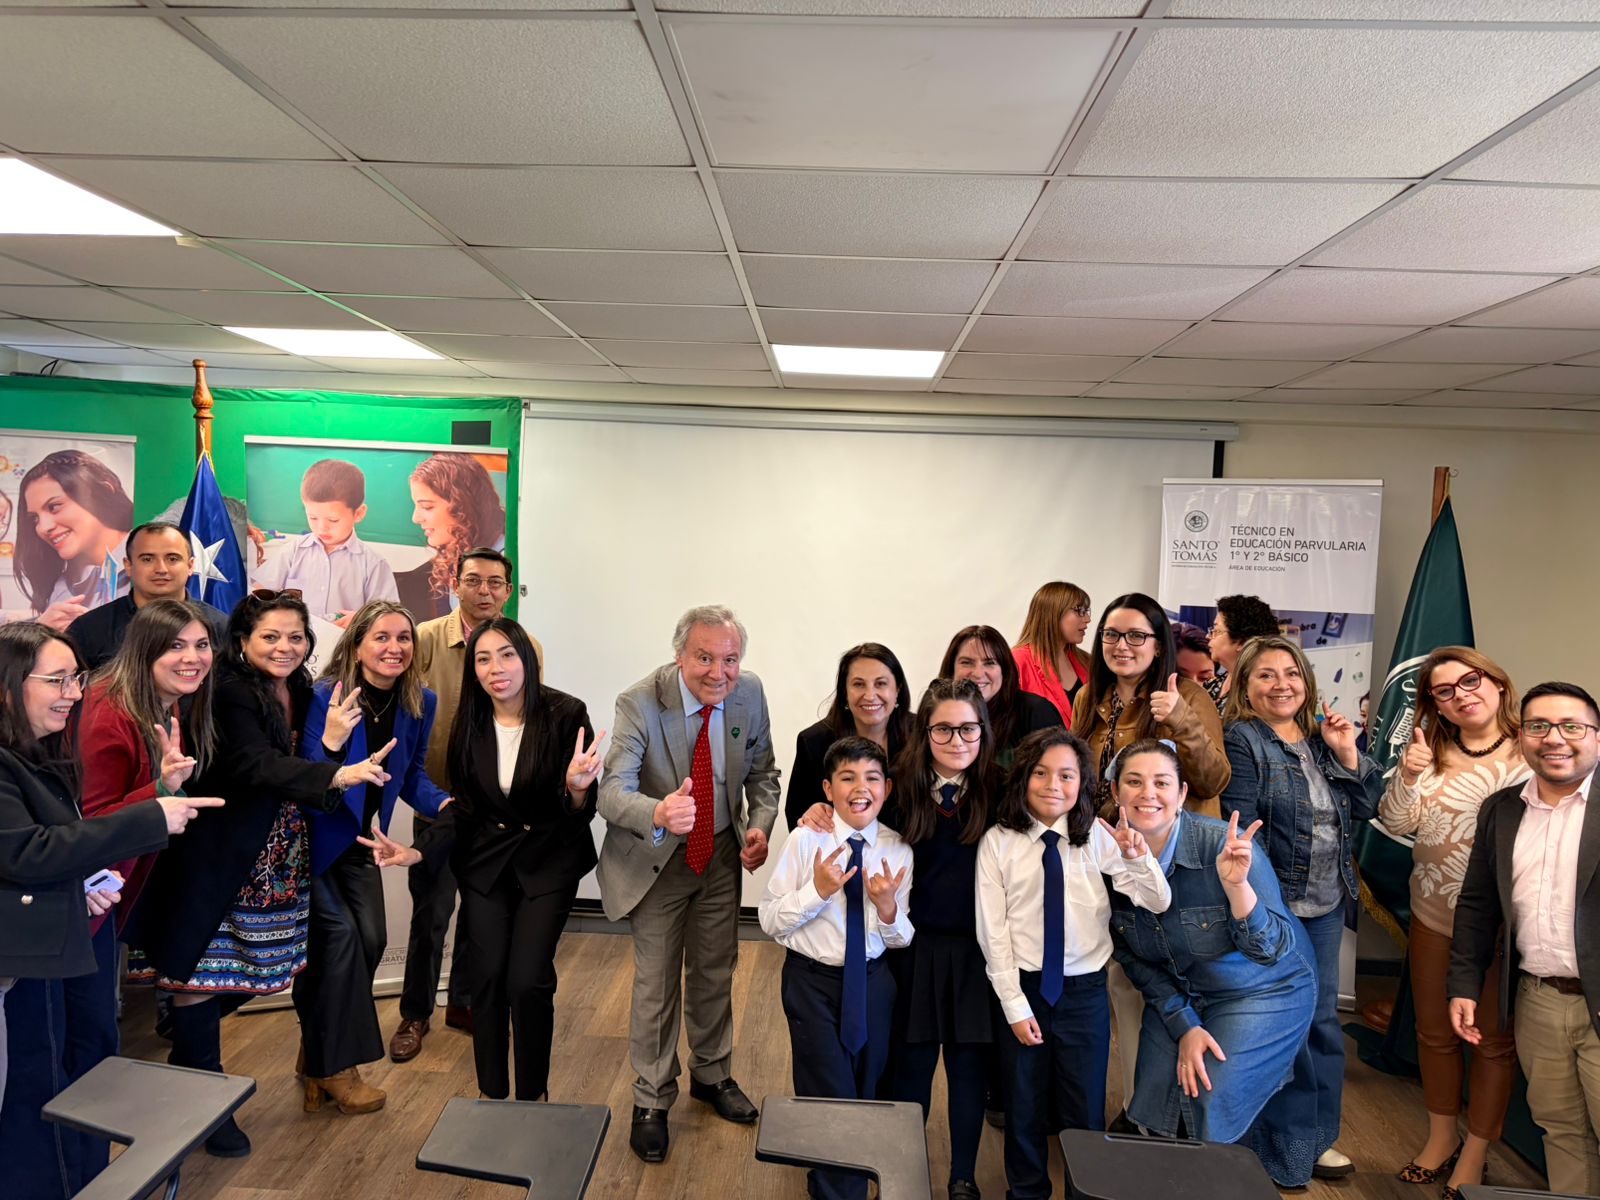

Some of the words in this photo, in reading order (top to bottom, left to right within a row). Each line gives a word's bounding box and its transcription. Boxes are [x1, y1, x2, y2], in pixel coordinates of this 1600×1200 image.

[1231, 525, 1276, 537] TÉCNICO
[1280, 527, 1295, 537] EN
[1172, 540, 1219, 551] SANTO
[1230, 538, 1292, 549] EDUCACIÓN
[1294, 540, 1367, 551] PARVULARIA
[1172, 550, 1218, 561] TOMÁS
[1243, 551, 1250, 561] Y
[1268, 551, 1309, 562] BÁSICO
[1316, 636, 1327, 645] de
